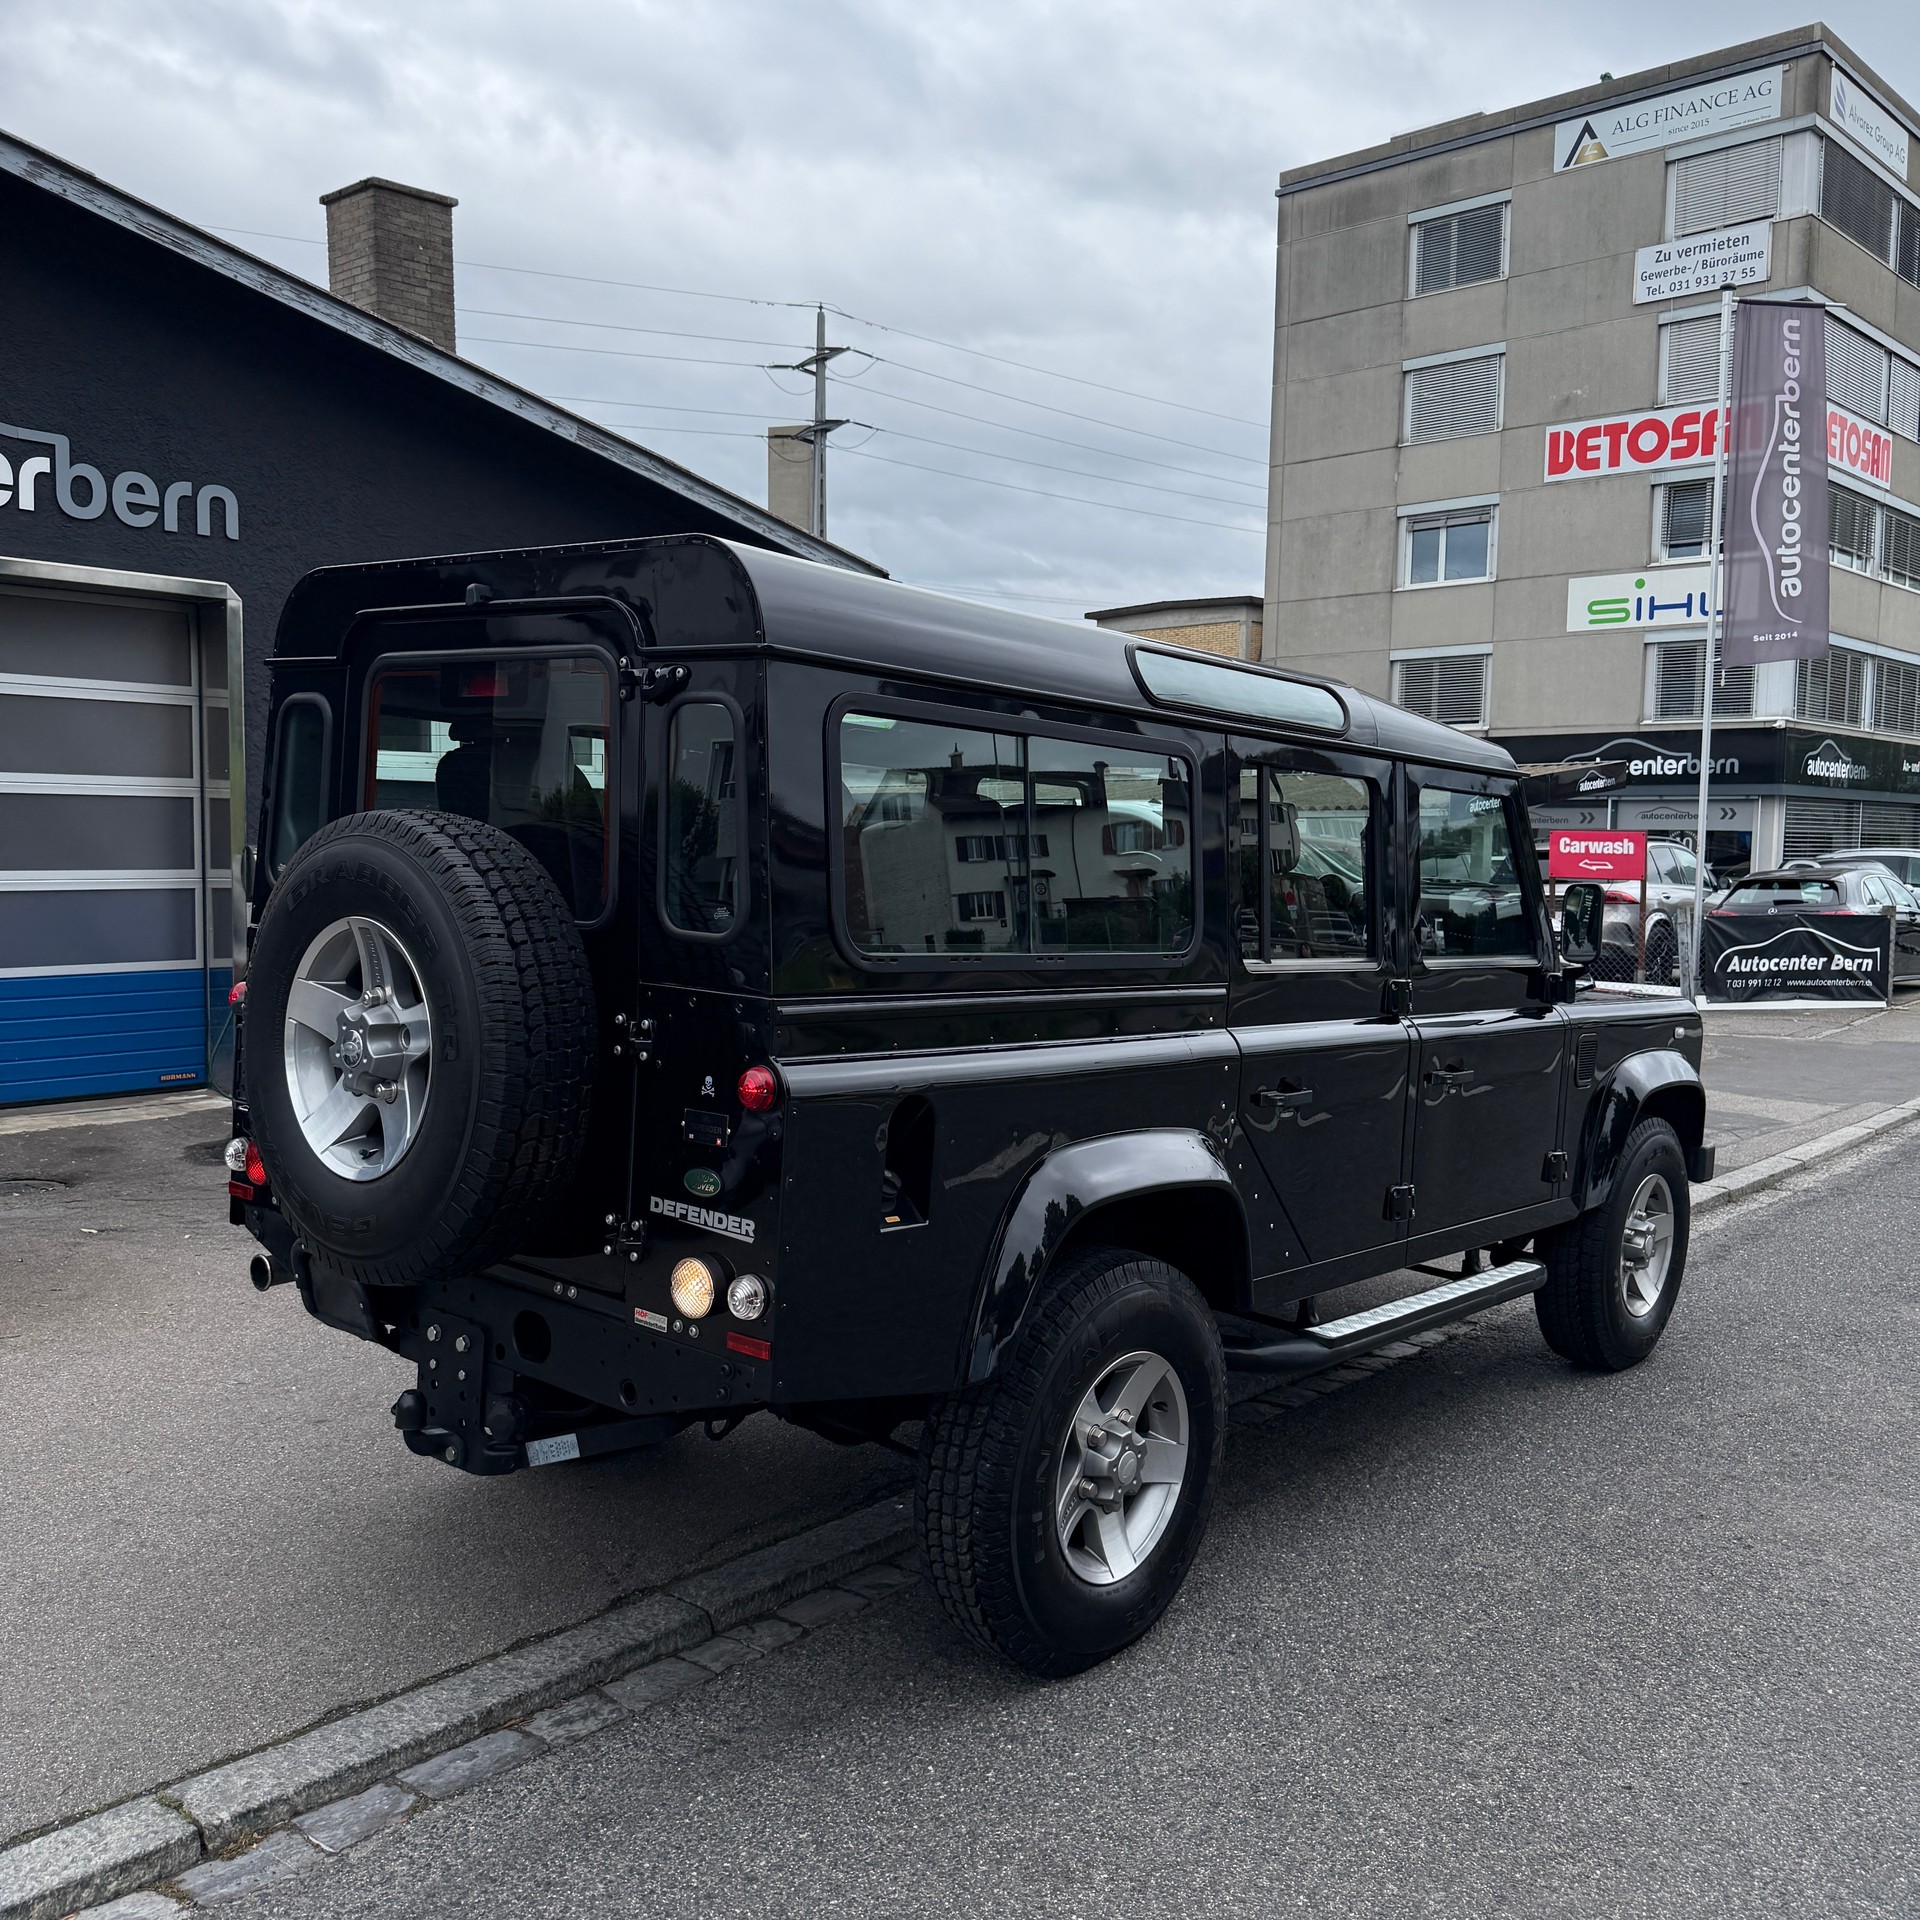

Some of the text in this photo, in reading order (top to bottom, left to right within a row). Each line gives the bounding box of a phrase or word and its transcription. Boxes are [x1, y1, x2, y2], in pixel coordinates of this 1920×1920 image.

[1612, 80, 1772, 136] ALG FINANCE AG
[1668, 117, 1710, 136] since 2015
[1849, 103, 1906, 164] Alvarez Group AG
[1655, 234, 1750, 264] Zu vermieten
[1701, 250, 1765, 271] Büroräume
[1646, 266, 1756, 297] Tel. 031 931 37 55
[1548, 406, 1730, 477] BETOSA
[1828, 410, 1891, 484] ETOSAN
[1775, 318, 1802, 598] autocenterbern
[1753, 631, 1798, 642] Seit 2014
[1626, 752, 1739, 776] enterbrn
[1806, 756, 1867, 780] autocenterbern
[1579, 777, 1616, 792] autocenterbern
[1469, 797, 1501, 813] autocenter
[1641, 811, 1700, 821] autocenterbe
[1559, 837, 1635, 855] Carwash
[1726, 953, 1874, 973] Autocenter Bern
[1726, 979, 1732, 988] T
[1732, 979, 1746, 988] 031
[1748, 979, 1762, 988] 991
[1786, 978, 1873, 987] www.autocenterbern.ch
[693, 1182, 715, 1193] OVER
[650, 1195, 756, 1238] DEFENDER
